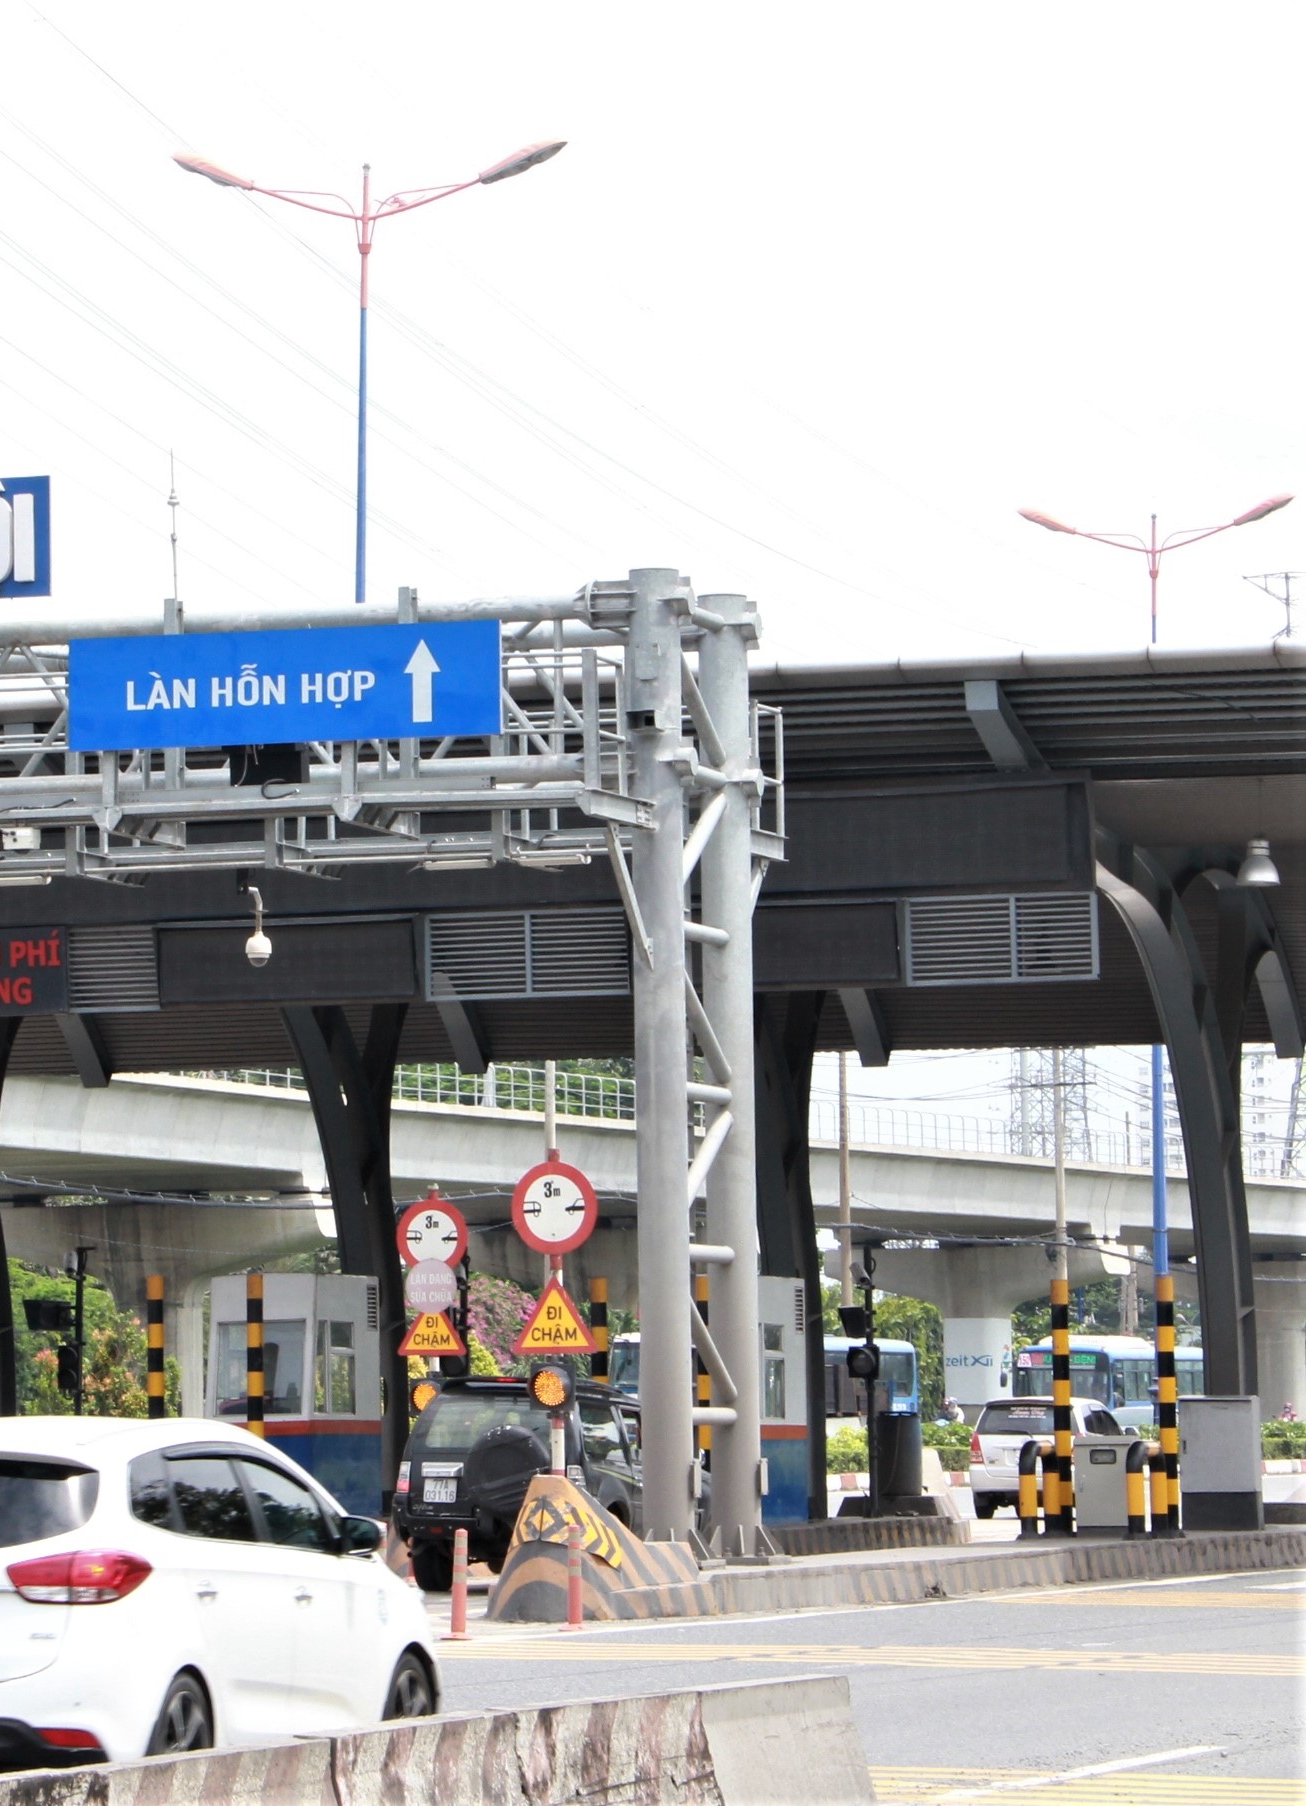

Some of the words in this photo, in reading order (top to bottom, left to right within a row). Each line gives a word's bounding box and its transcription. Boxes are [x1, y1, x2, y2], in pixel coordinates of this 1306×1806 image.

[127, 671, 196, 711] LÀN
[211, 663, 286, 708] HỖN
[301, 669, 376, 709] HỢP
[9, 931, 61, 967] PHÍ
[426, 1316, 438, 1329] ĐI
[547, 1306, 562, 1320] ĐI
[531, 1323, 578, 1345] CHẬM
